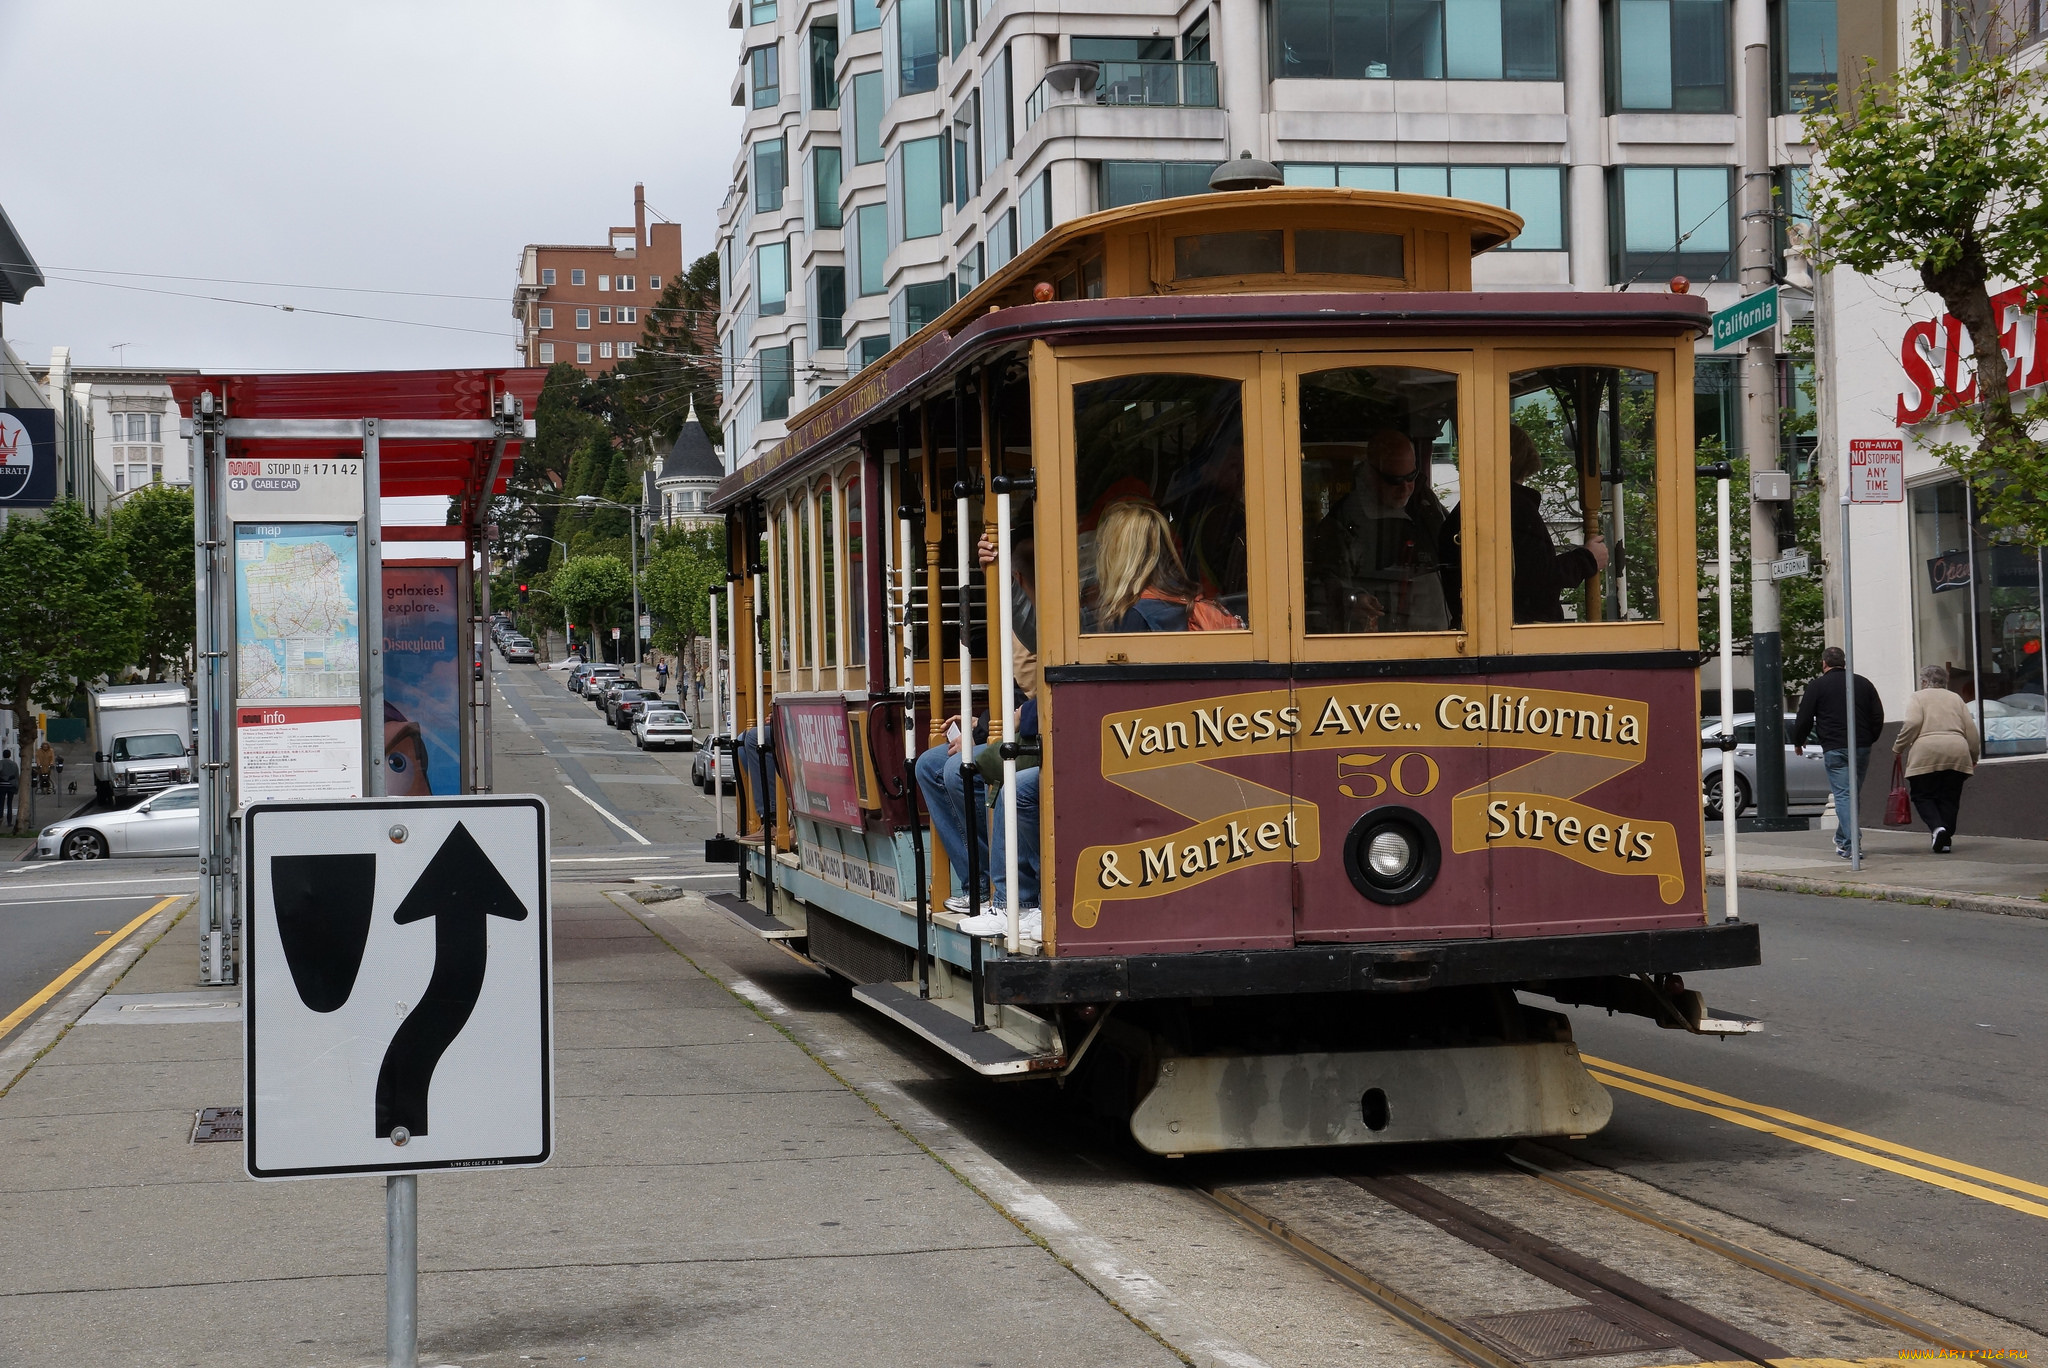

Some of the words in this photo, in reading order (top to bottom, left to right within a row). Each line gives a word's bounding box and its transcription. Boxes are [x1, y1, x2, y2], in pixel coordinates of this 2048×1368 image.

[1717, 301, 1772, 339] California
[849, 381, 880, 419] CALIFORNIA
[1853, 441, 1898, 449] TOW-AWAY
[1851, 450, 1866, 464] NO
[1867, 453, 1901, 465] STOPPING
[267, 463, 290, 475] STOP
[292, 463, 301, 475] ID
[312, 463, 357, 475] 17142
[1866, 467, 1887, 478] ANY
[231, 480, 245, 489] 61
[254, 480, 280, 489] CABLE
[281, 480, 298, 489] CAR
[1865, 480, 1889, 491] TIME
[257, 526, 281, 538] map
[1773, 560, 1806, 575] CALIFORNIA
[387, 584, 444, 599] galaxies!
[388, 600, 439, 616] explore.
[382, 636, 445, 653] Disneyland
[263, 711, 285, 724] info
[1110, 717, 1190, 760] Van
[1191, 706, 1302, 748] Ness
[1435, 693, 1640, 745] California
[798, 714, 829, 764] BREAK
[824, 714, 840, 766] UP
[1337, 752, 1440, 799] 50
[1486, 800, 1656, 864] Streets
[805, 847, 815, 867] SAN
[1099, 850, 1133, 889] &
[1138, 811, 1300, 888] Market
